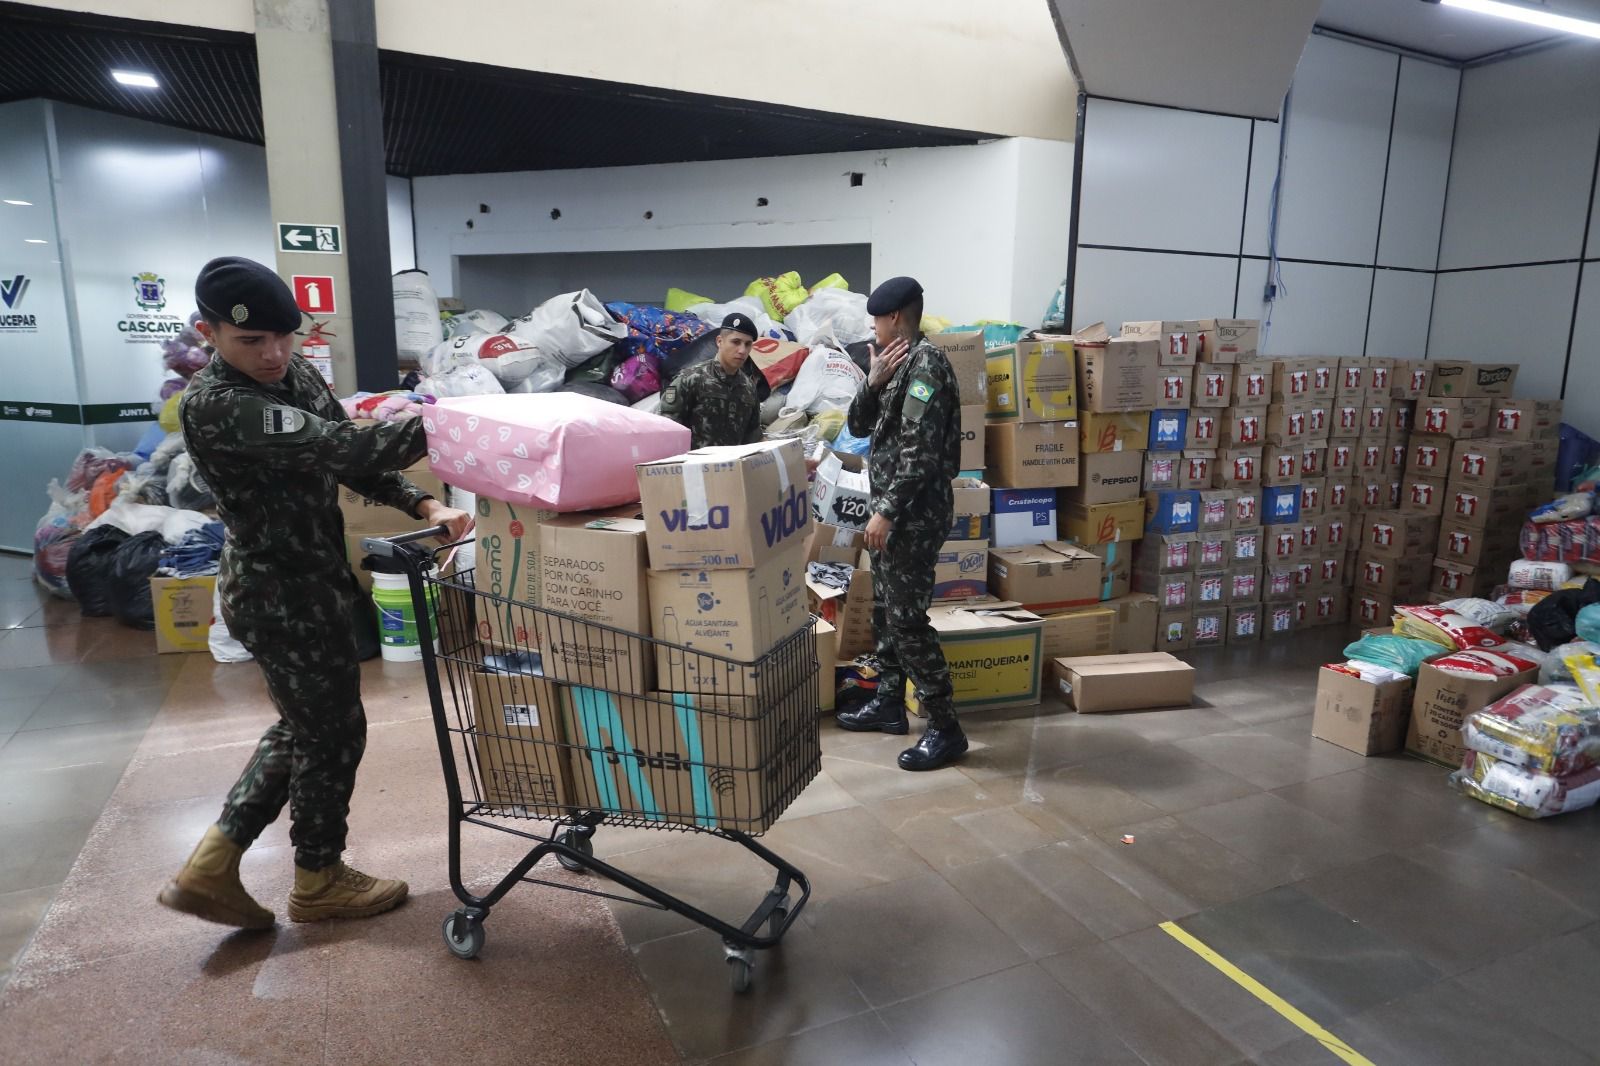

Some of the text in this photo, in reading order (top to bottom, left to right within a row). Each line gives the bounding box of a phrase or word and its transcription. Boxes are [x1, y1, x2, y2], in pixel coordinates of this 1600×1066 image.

[117, 320, 184, 333] CASCAVE
[938, 344, 975, 352] tval.com
[987, 374, 1007, 386] QUEIRA
[118, 409, 150, 417] JUNTA
[1035, 443, 1064, 452] FRAGILE
[1061, 457, 1076, 465] CARE
[646, 464, 709, 476] LAVA LOS
[1102, 475, 1138, 486] PEPSICO
[841, 500, 866, 517] 120
[660, 499, 729, 532] via
[761, 484, 808, 548] vida
[1035, 512, 1047, 521] PS
[543, 556, 605, 572] SEPARADOS
[701, 554, 739, 566] 500 ml
[544, 569, 563, 580] POR
[545, 582, 623, 600] COM CARINHO
[546, 595, 569, 608] PARA
[948, 655, 1023, 669] MANTIQUEIRA
